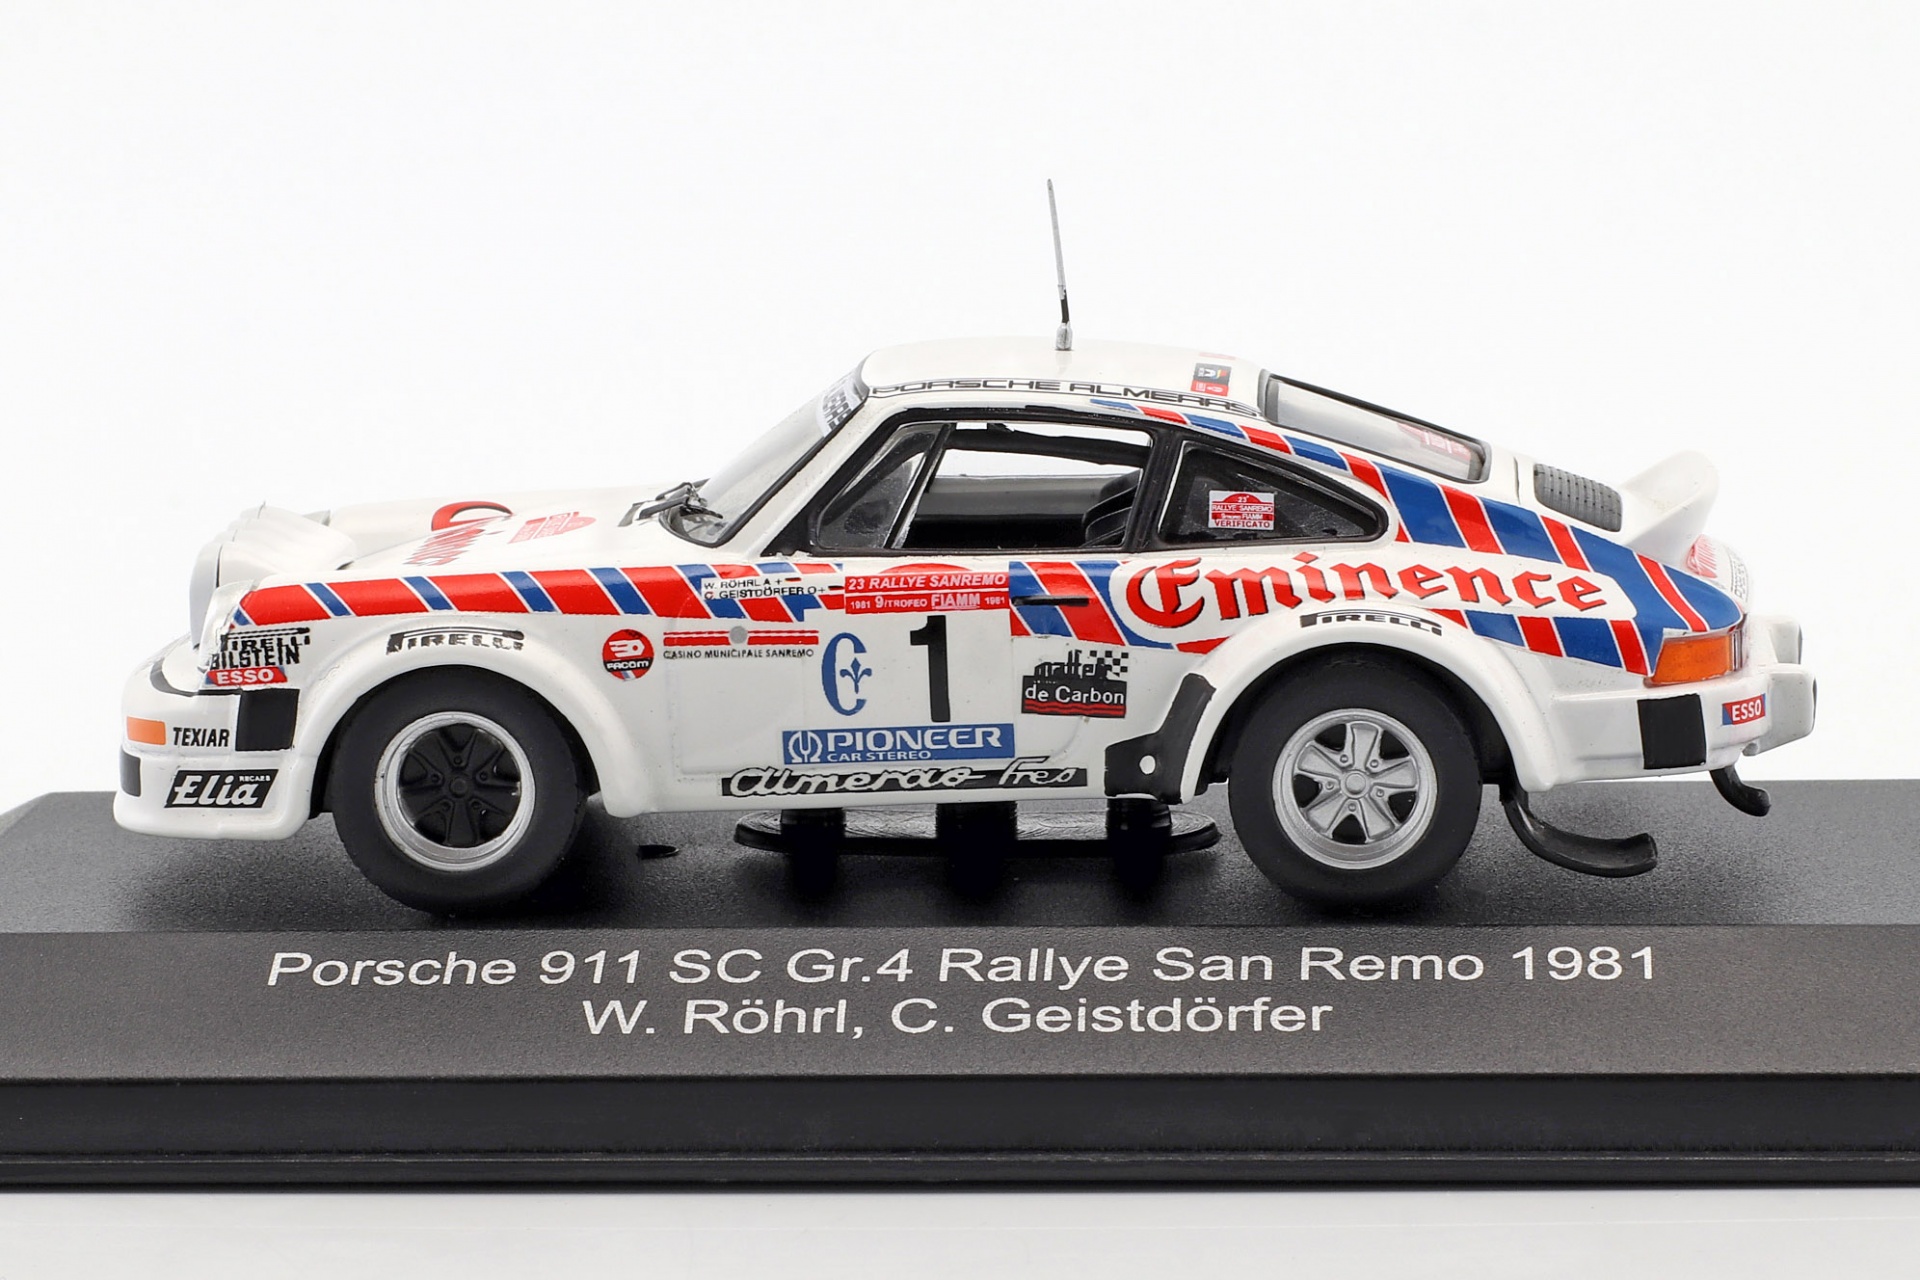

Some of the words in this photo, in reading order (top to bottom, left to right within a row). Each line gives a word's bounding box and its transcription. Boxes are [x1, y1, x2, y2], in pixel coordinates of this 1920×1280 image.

[872, 380, 1061, 395] PORSCHE
[1212, 504, 1237, 513] RALLYE
[1239, 504, 1273, 513] SANREMO
[1215, 520, 1271, 528] VERIFICATO
[720, 579, 760, 589] RÖHRL
[848, 578, 865, 590] 23
[869, 576, 926, 589] RALLYE
[929, 574, 1006, 587] SANREMO
[1126, 551, 1607, 629] Eminence
[719, 586, 804, 599] GEISTDÖRFER
[851, 600, 871, 610] 1981
[931, 593, 981, 608] FIAMM
[1300, 609, 1442, 636] PIRELLI
[219, 627, 310, 652] PIRELLI
[386, 626, 525, 655] PIRELLI
[210, 644, 300, 671] BILSTEIN
[663, 650, 701, 660] CASINO
[704, 649, 763, 658] MUNICIPALE
[766, 648, 814, 658] SANREMO
[216, 668, 274, 684] ESSO
[910, 614, 950, 722] 1
[1025, 684, 1049, 702] de
[1055, 686, 1124, 704] Carbon
[1731, 699, 1762, 722] ESSO
[173, 727, 230, 747] TEXIAR
[826, 727, 1002, 752] PIONEER
[827, 752, 864, 762] CAR
[866, 750, 931, 761] STEREO
[172, 775, 259, 806] Elia
[268, 951, 516, 986] Porsche
[540, 950, 639, 985] 911
[670, 949, 762, 984] SC
[787, 948, 913, 983] Gr.4
[939, 947, 1128, 991] Rallye
[1153, 946, 1272, 982] San
[1301, 946, 1484, 981] Remo
[1513, 946, 1652, 981] 1981
[583, 999, 654, 1035] W.
[684, 998, 862, 1039] Röhrl,
[891, 997, 953, 1034] C.
[982, 996, 1333, 1033] Geistdörfer
